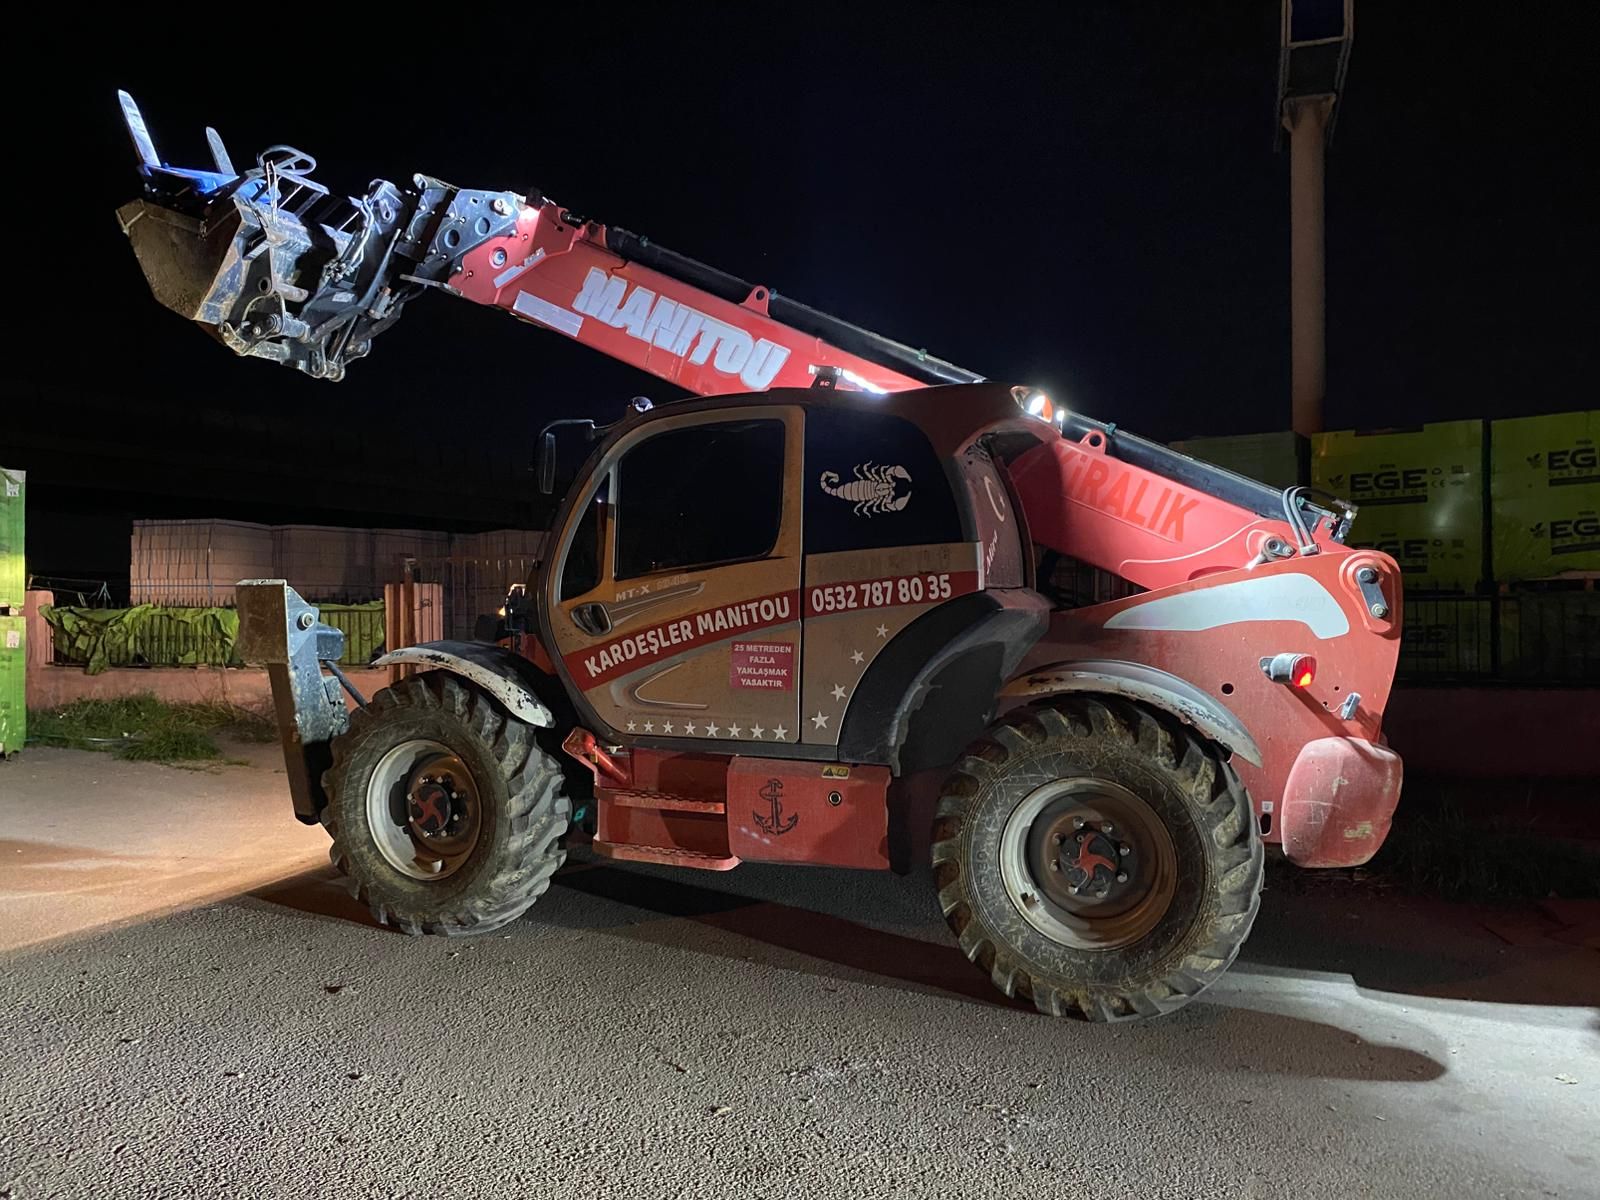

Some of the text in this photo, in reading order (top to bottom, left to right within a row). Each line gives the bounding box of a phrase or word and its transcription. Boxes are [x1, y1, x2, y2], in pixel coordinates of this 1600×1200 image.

[572, 266, 791, 390] MANITOU
[1350, 468, 1427, 491] EGE
[616, 584, 650, 602] MT-X
[812, 574, 952, 612] 0532 787 80 35
[584, 620, 694, 678] KARDEŞLER
[734, 644, 791, 653] 25 METREDEN
[749, 656, 775, 664] FAZLA
[736, 667, 787, 677] YAKLAŞMAK
[741, 678, 783, 687] YASAKTIR
